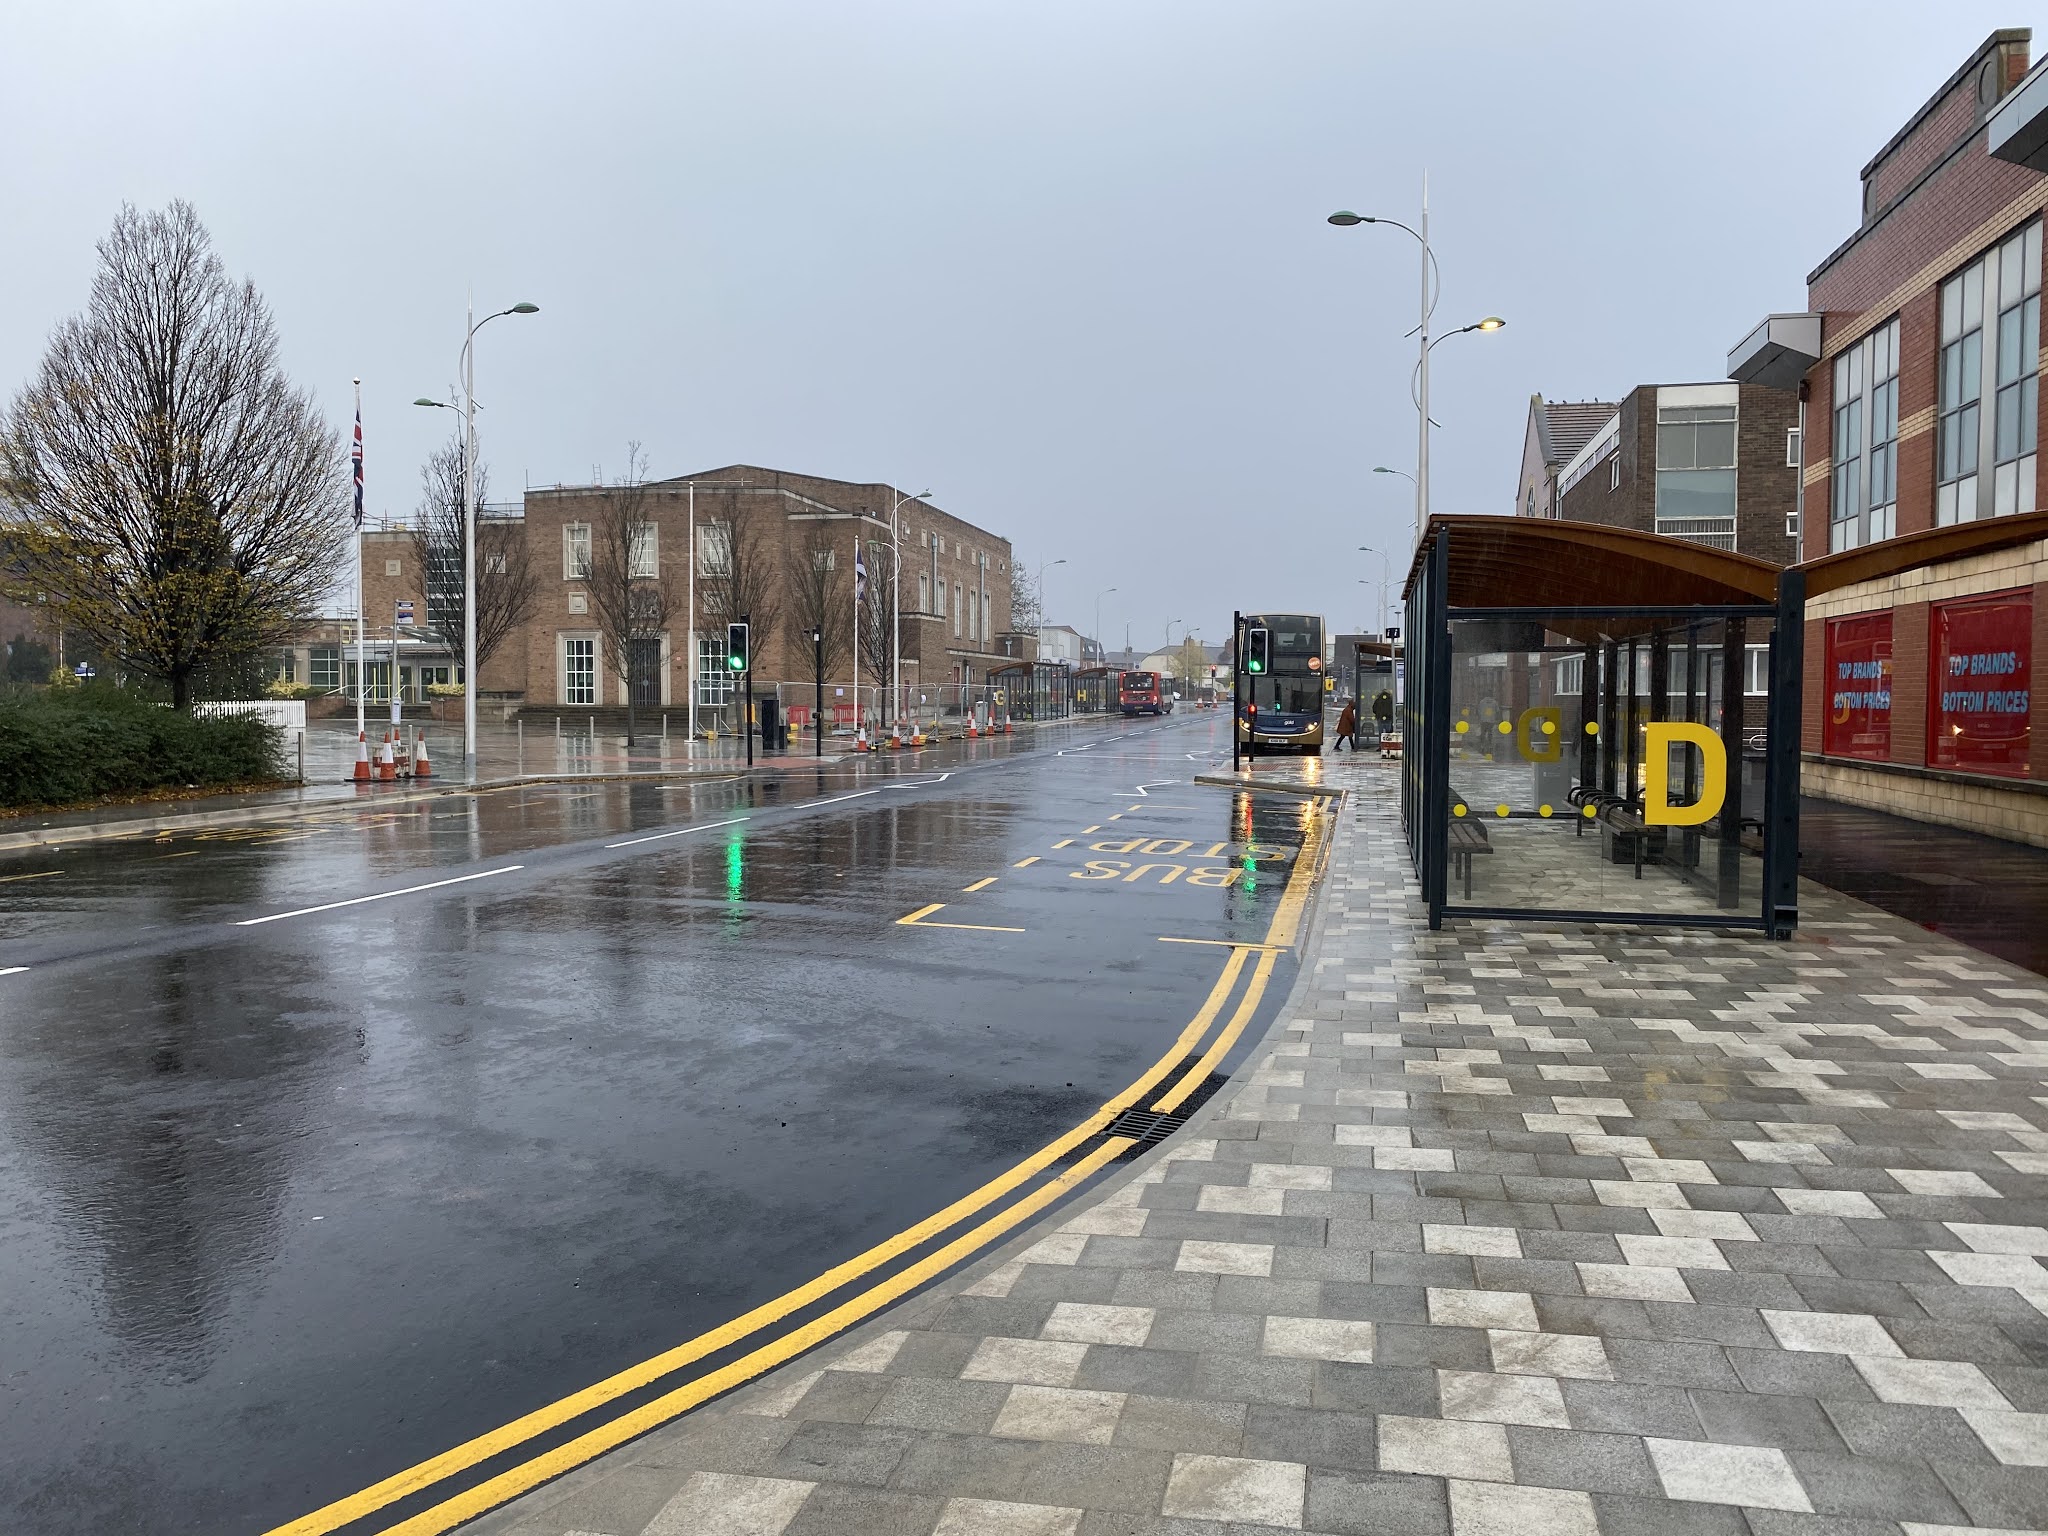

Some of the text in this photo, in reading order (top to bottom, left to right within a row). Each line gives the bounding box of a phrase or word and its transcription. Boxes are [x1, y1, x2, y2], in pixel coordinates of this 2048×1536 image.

[1838, 661, 1882, 680] TOP BRANDS
[1950, 655, 1969, 677] TOP
[1970, 652, 2016, 675] BRANDS
[1077, 689, 1087, 702] H
[1834, 691, 1891, 710] BOTTOM PRICES
[1942, 690, 2029, 713] BOTTOM PRICES
[1644, 722, 1727, 826] D
[1088, 838, 1292, 861] STOP
[1069, 860, 1245, 887] BUS
